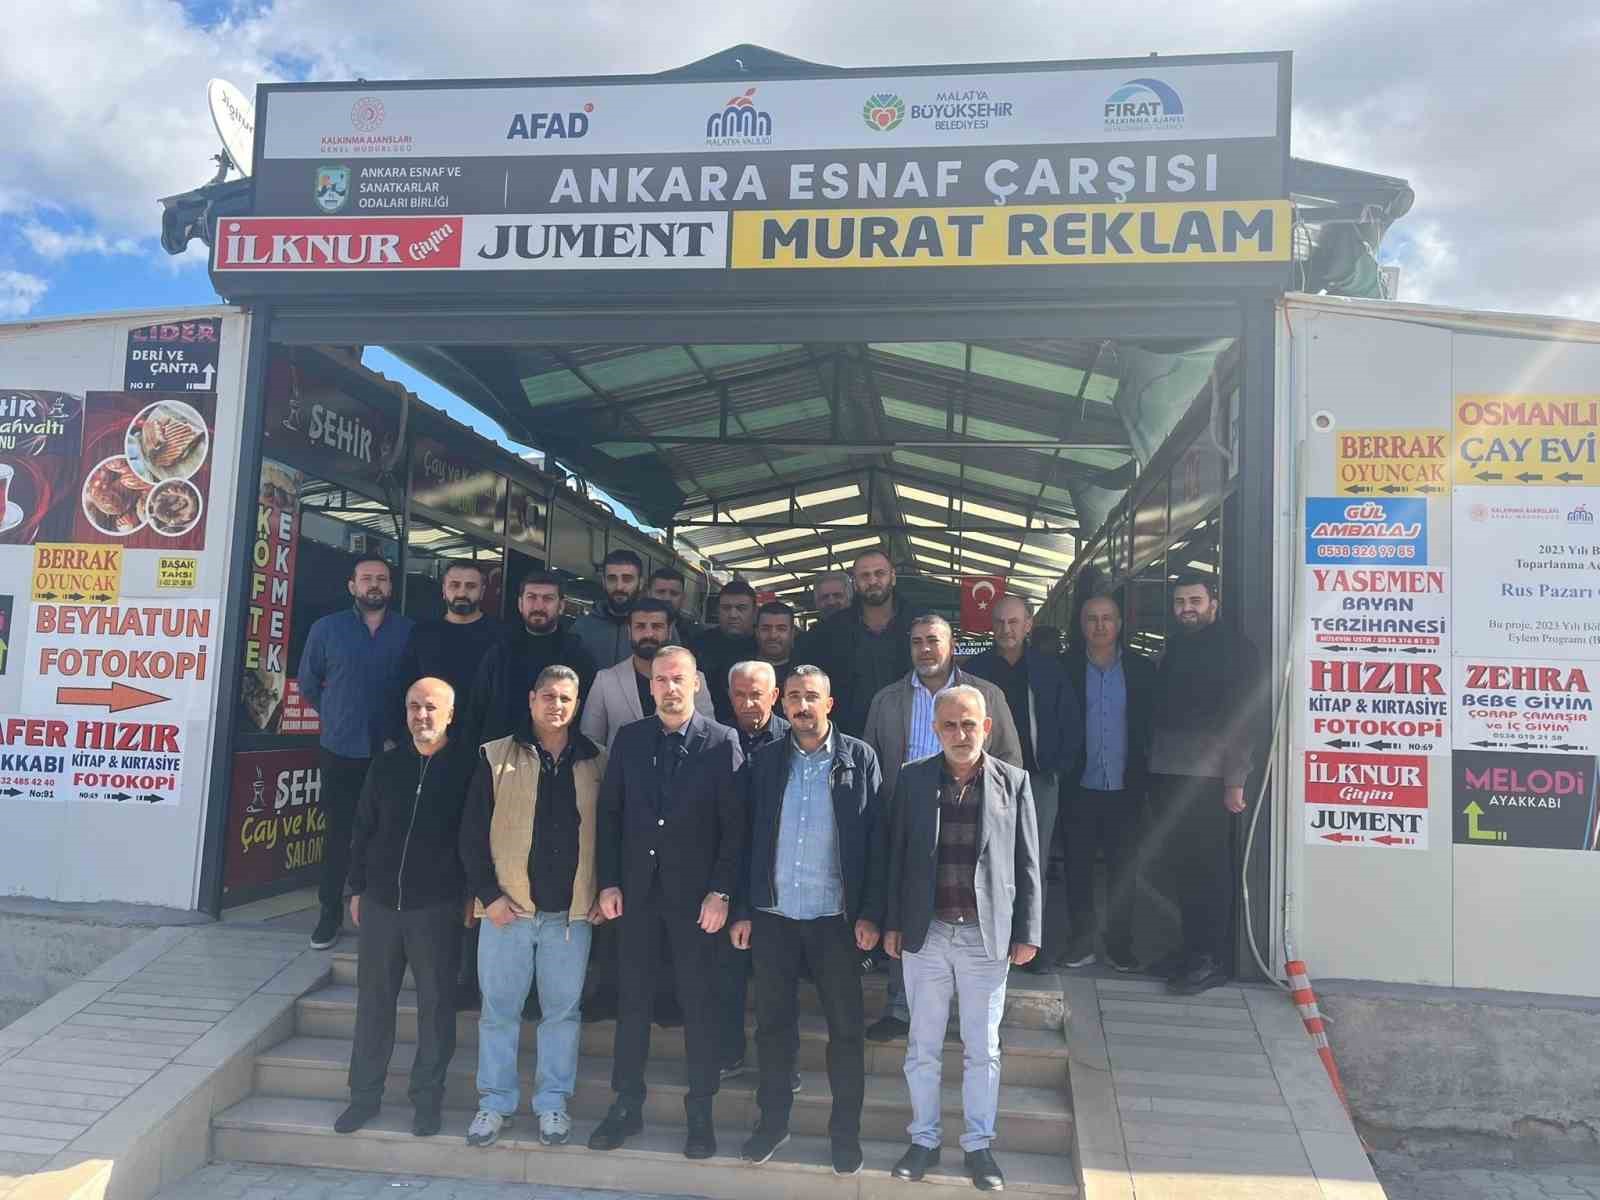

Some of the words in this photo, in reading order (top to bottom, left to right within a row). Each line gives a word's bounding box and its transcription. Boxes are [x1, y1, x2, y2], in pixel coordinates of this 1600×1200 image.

[937, 90, 988, 101] MALATYA
[911, 102, 1013, 119] BÜYÜKŞEHİR
[1104, 102, 1161, 117] FIRAT
[507, 111, 589, 139] AFAD
[321, 135, 366, 145] KALKINMA
[367, 135, 412, 145] AJANSLARI
[360, 167, 407, 178] ANKARA
[410, 167, 445, 177] ESNAF
[447, 166, 461, 177] VE
[550, 164, 767, 204] ANKARA
[789, 159, 963, 200] ESNAF
[985, 153, 1218, 206] ÇARŞISI
[360, 182, 439, 193] SANATKARLAR
[359, 198, 409, 208] ODALARI
[411, 195, 449, 208] BİRLİĞİ
[225, 222, 402, 265] İLKNUR
[478, 221, 714, 259] JUMENT
[762, 214, 984, 260] MURAT
[1008, 209, 1274, 256] REKLAM
[133, 347, 163, 361] DERİ
[167, 350, 184, 361] VE
[150, 363, 198, 375] ÇANTA
[1458, 401, 1598, 426] OSMANLI
[309, 404, 372, 463] ŞEHİR
[1341, 436, 1446, 458] BERRAK
[1460, 438, 1532, 469] ÇAY
[1541, 432, 1596, 463] EVİ
[1342, 463, 1445, 482] OYUNCAK
[1345, 503, 1385, 519] GÜL
[1312, 524, 1421, 538] AMBALAJ
[1353, 545, 1376, 556] 326
[1538, 544, 1565, 554] 2023
[1568, 545, 1588, 555] Yılı
[38, 549, 118, 571] BERRAK
[161, 559, 194, 570] BAŞAK
[1516, 559, 1584, 571] Toparlanma
[36, 573, 116, 591] OYUNCAK
[245, 504, 273, 669] KÖFTE
[1313, 570, 1445, 593] YASEMEN
[1501, 583, 1533, 597] Rus
[1539, 584, 1593, 598] Pazarı
[267, 512, 293, 672] EKMEK
[1343, 597, 1414, 611] BAYAN
[36, 605, 211, 638] BEYHATUN
[1311, 615, 1446, 633] TERZİHANESİ
[39, 645, 207, 681] FOTOKOPİ
[1309, 660, 1446, 695] HIZIR
[1465, 664, 1591, 693] ZEHRA
[1309, 694, 1351, 712] KİTAP
[1356, 699, 1367, 713] &
[1372, 697, 1447, 716] KIRTASİYE
[1462, 694, 1517, 708] BEBE
[1525, 693, 1592, 711] GİYİM
[1468, 710, 1518, 719] ÇORAP
[1523, 711, 1588, 723] ÇAMAŞIR
[75, 720, 181, 753] HIZIR
[1314, 718, 1443, 737] FOTOKOPİ
[72, 751, 106, 768] KİTAP
[108, 757, 118, 767] &
[121, 754, 181, 772] KIRTASİYE
[1309, 754, 1424, 787] İLKNUR
[73, 773, 175, 790] FOTOKOPİ
[1339, 786, 1394, 803] Giyim
[1489, 795, 1561, 809] AYAKKABI
[1310, 810, 1422, 833] JUMENT
[241, 816, 277, 853] Çay
[283, 814, 303, 837] ve
